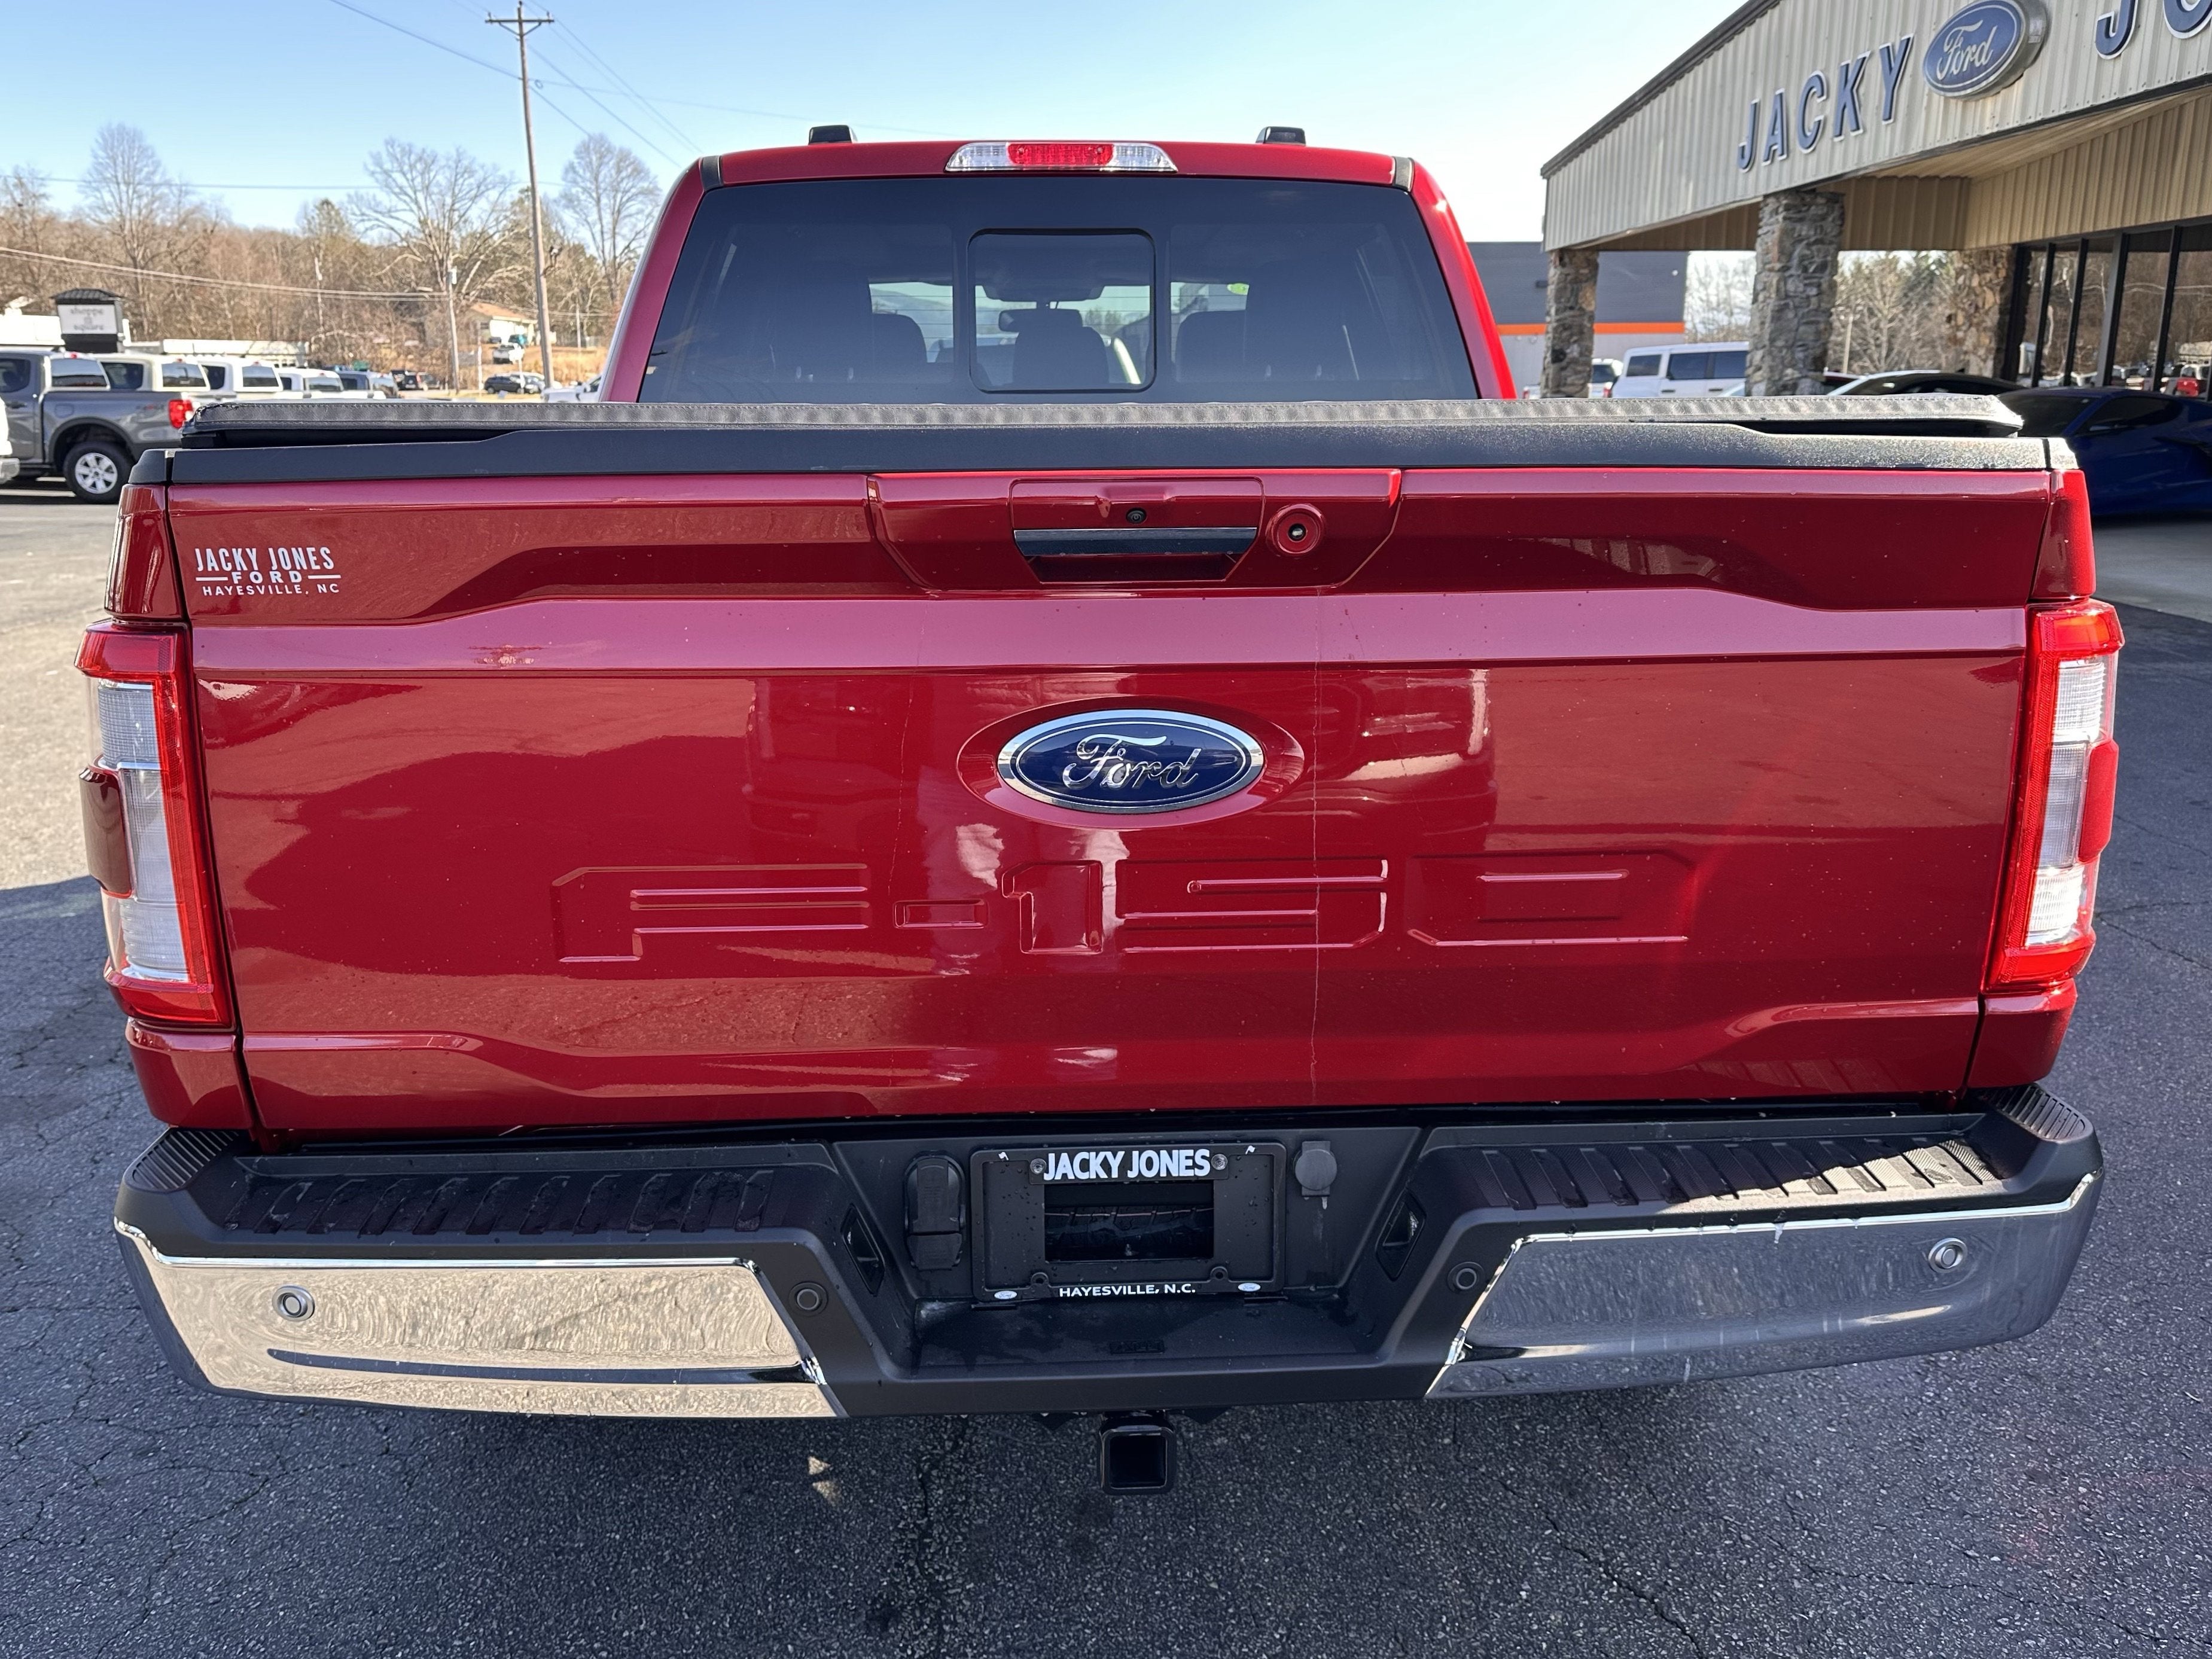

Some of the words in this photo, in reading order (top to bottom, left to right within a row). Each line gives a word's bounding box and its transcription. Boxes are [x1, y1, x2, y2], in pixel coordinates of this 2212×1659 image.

[1937, 20, 1995, 80] Ford
[1737, 33, 1914, 173] JACKY
[194, 548, 259, 572] JACKY
[268, 547, 335, 571] JONES
[231, 571, 303, 584] FORD
[317, 583, 340, 594] NC
[1062, 733, 1202, 790] Ford
[550, 848, 1694, 963] F-150
[1043, 1151, 1125, 1181] JACKY
[1127, 1148, 1211, 1179] JONES
[1059, 1284, 1160, 1297] HAYESVILLE,
[1164, 1283, 1196, 1294] N.C.
